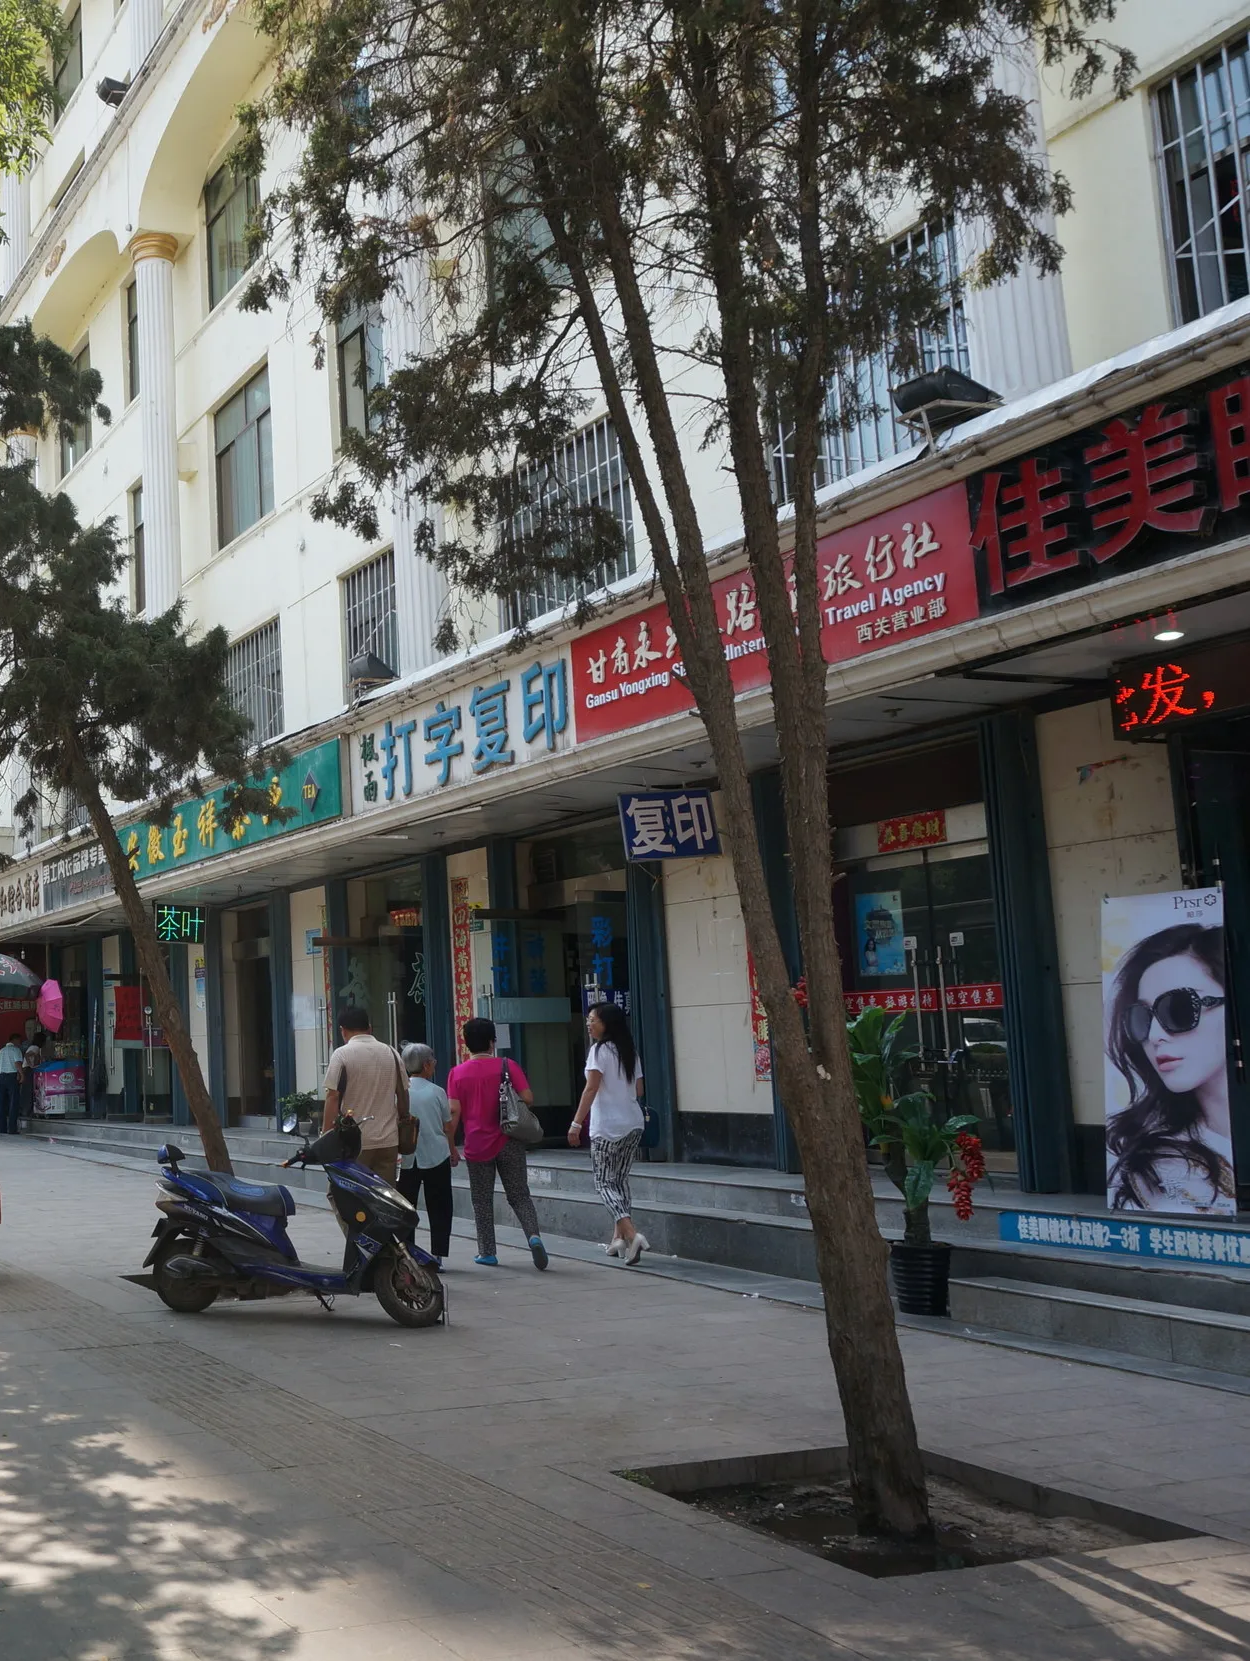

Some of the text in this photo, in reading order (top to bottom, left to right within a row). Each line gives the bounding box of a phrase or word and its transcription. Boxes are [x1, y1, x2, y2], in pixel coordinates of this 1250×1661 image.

[825, 572, 946, 626] Travel Agency
[856, 596, 947, 644] 西关营业部
[585, 671, 670, 710] Gansu Yongxing
[380, 659, 568, 801] 打字复印
[302, 784, 317, 799] TEA
[624, 797, 714, 856] 复印
[158, 905, 205, 943] 茶叶
[1173, 896, 1202, 910] Prsr
